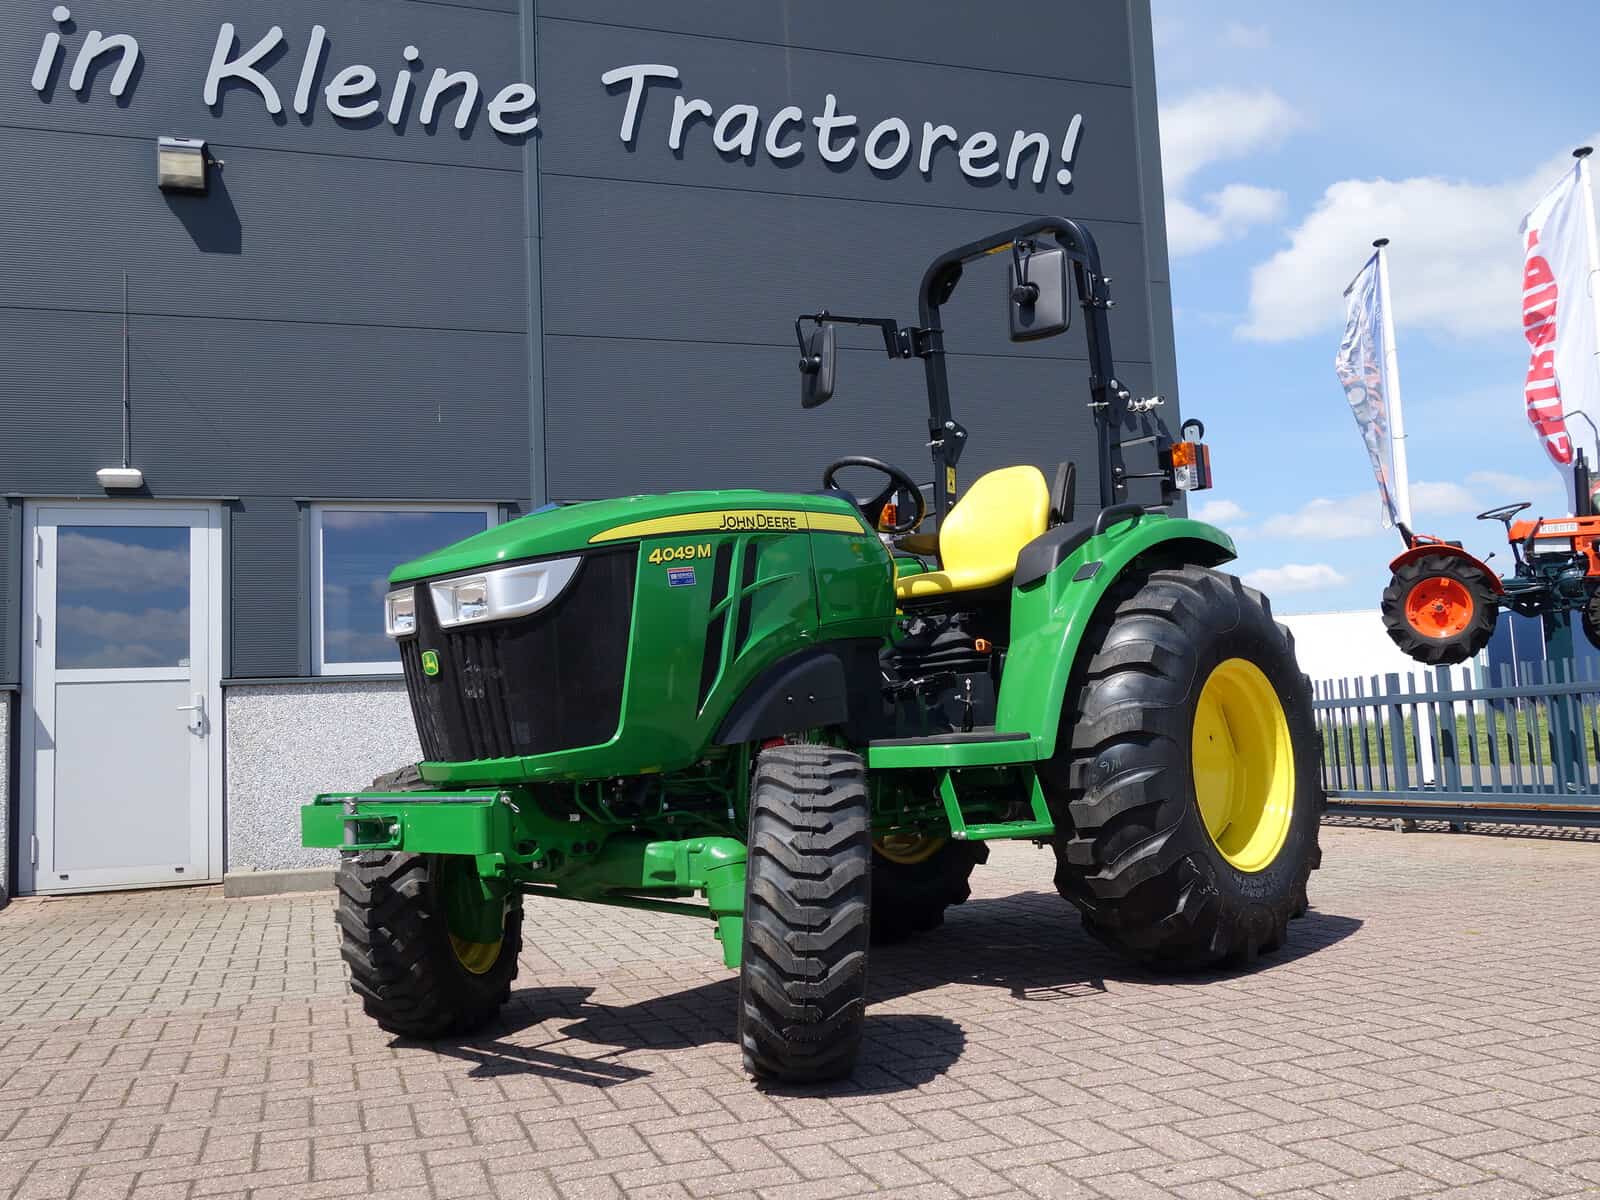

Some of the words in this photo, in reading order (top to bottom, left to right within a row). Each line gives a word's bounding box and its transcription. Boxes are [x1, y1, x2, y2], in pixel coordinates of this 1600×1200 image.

[31, 6, 139, 96] in
[203, 22, 538, 135] Kleine
[601, 64, 1082, 185] Tractoren!
[719, 513, 755, 529] JOHN
[756, 513, 798, 529] DEERE
